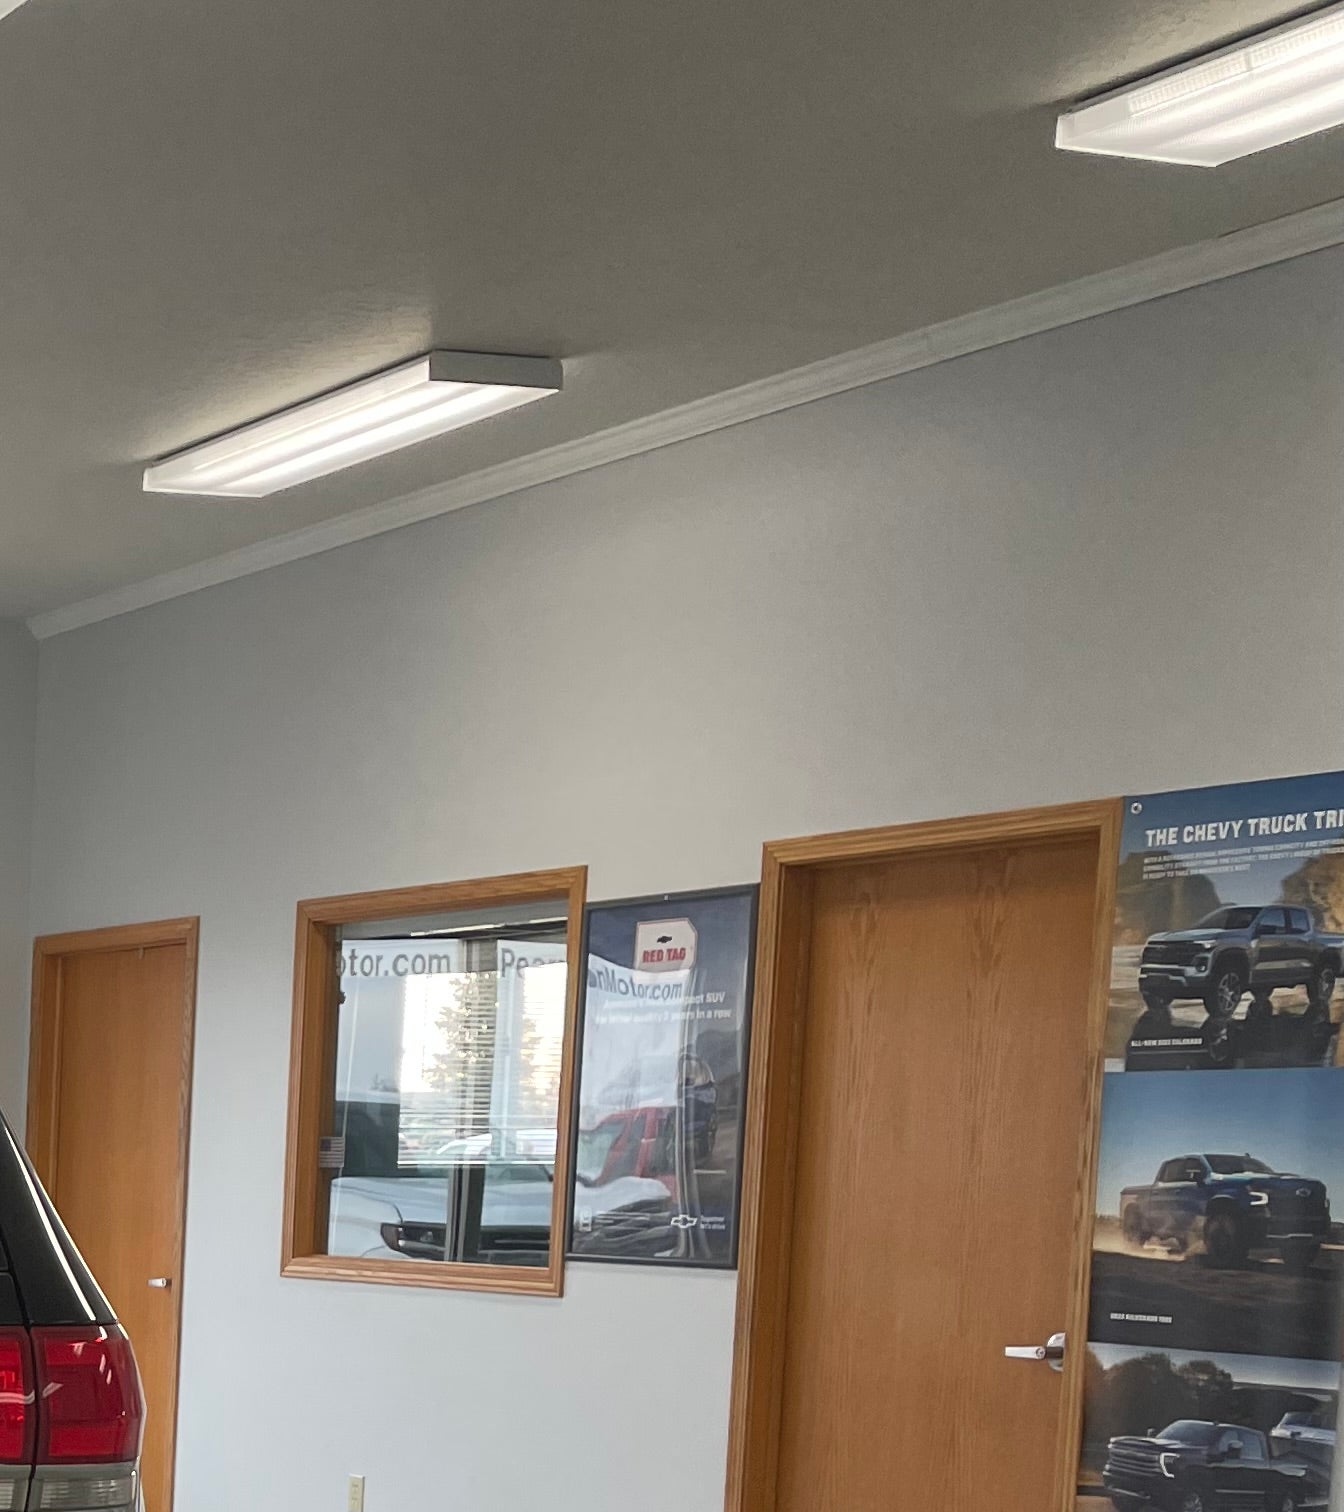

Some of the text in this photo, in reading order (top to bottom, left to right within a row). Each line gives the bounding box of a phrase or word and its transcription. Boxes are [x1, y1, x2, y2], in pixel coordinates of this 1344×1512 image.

[1145, 827, 1179, 847] THE
[1183, 820, 1244, 844] CHEVY
[1247, 812, 1308, 837] TRUCK
[643, 947, 687, 963] RED TAG
